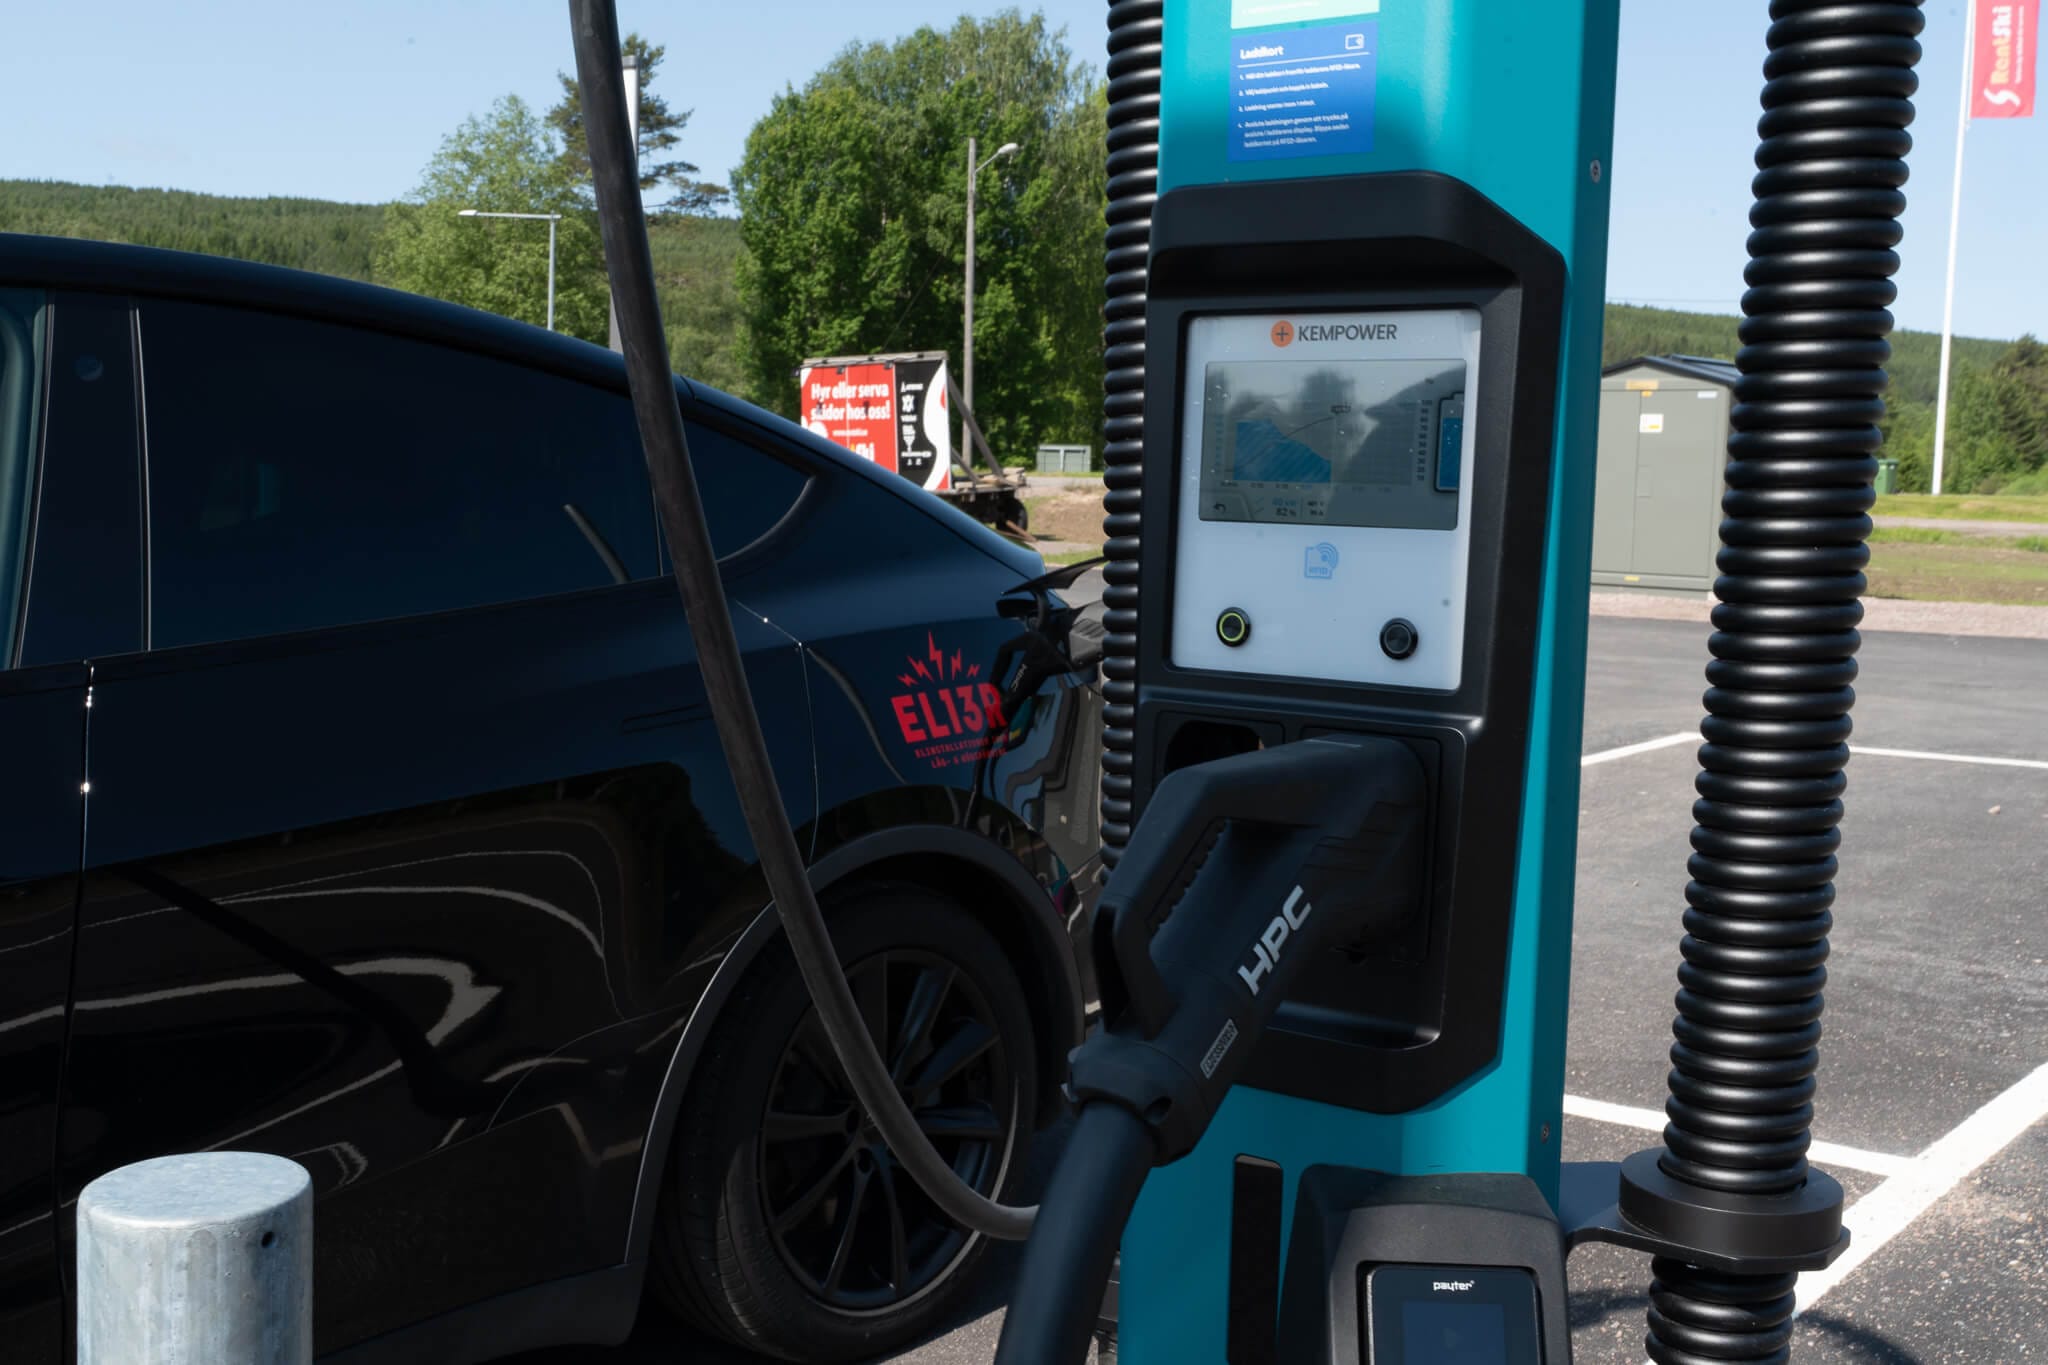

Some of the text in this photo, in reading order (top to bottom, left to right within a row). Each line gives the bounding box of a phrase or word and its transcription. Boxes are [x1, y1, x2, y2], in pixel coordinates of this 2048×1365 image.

[1298, 324, 1397, 342] KEMPOWER
[811, 383, 831, 402] Hyr
[832, 381, 857, 399] eller
[858, 384, 889, 398] serva
[867, 400, 891, 419] oss!
[890, 682, 1008, 744] EL13R
[1237, 884, 1312, 997] HPC
